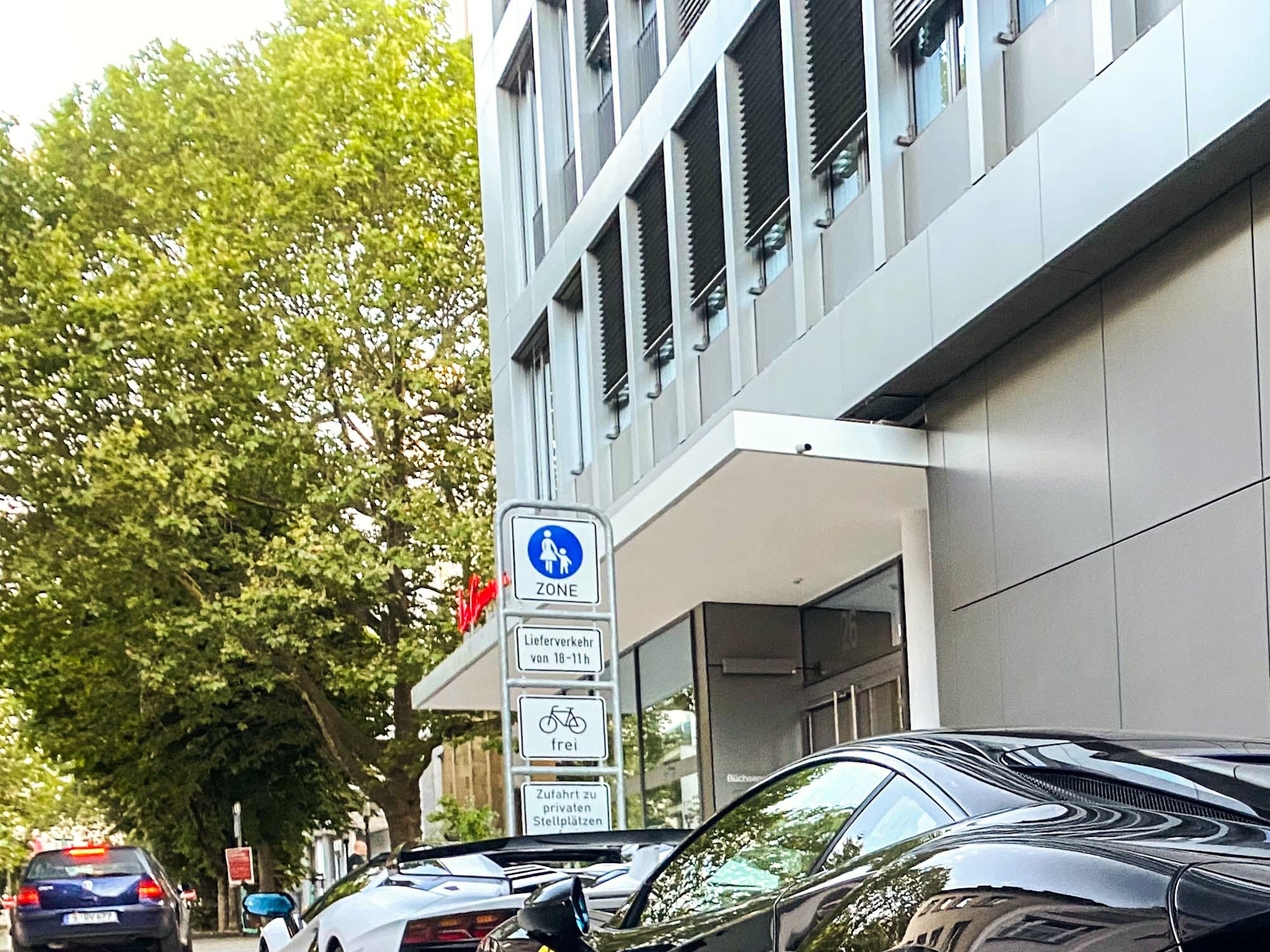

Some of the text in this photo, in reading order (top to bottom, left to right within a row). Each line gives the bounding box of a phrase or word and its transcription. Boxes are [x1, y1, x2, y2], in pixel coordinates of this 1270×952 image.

[536, 582, 578, 597] ZONE
[524, 634, 594, 648] Lieferverkehr
[530, 654, 549, 664] von
[552, 738, 577, 751] frei
[536, 789, 597, 799] Zufahrt zu
[543, 803, 591, 814] privaten
[533, 815, 603, 828] Stellplätzen
